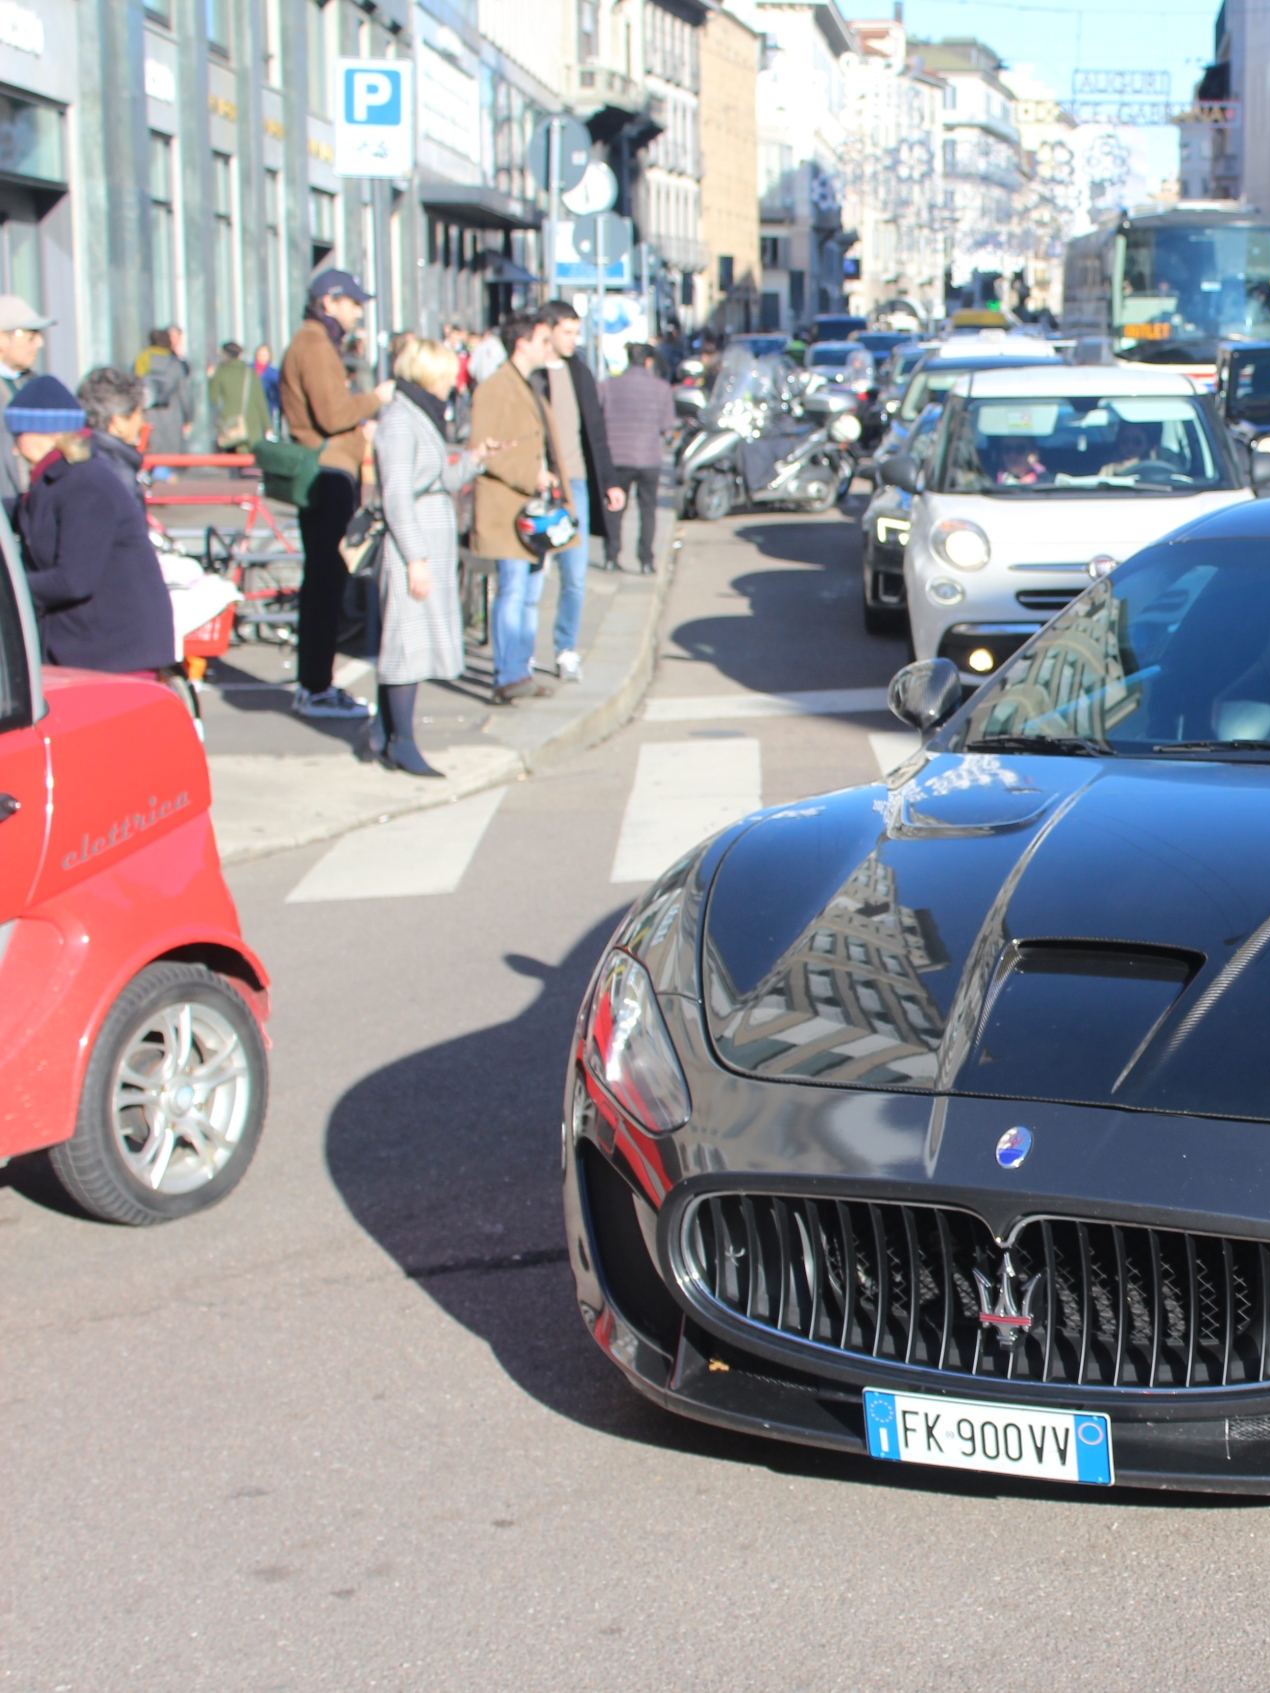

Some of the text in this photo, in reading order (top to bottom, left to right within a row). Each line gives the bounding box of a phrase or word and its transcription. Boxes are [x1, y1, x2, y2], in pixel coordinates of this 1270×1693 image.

[353, 72, 392, 121] P
[1079, 72, 1169, 93] AUGURI
[901, 1410, 1070, 1467] FK 900VV
